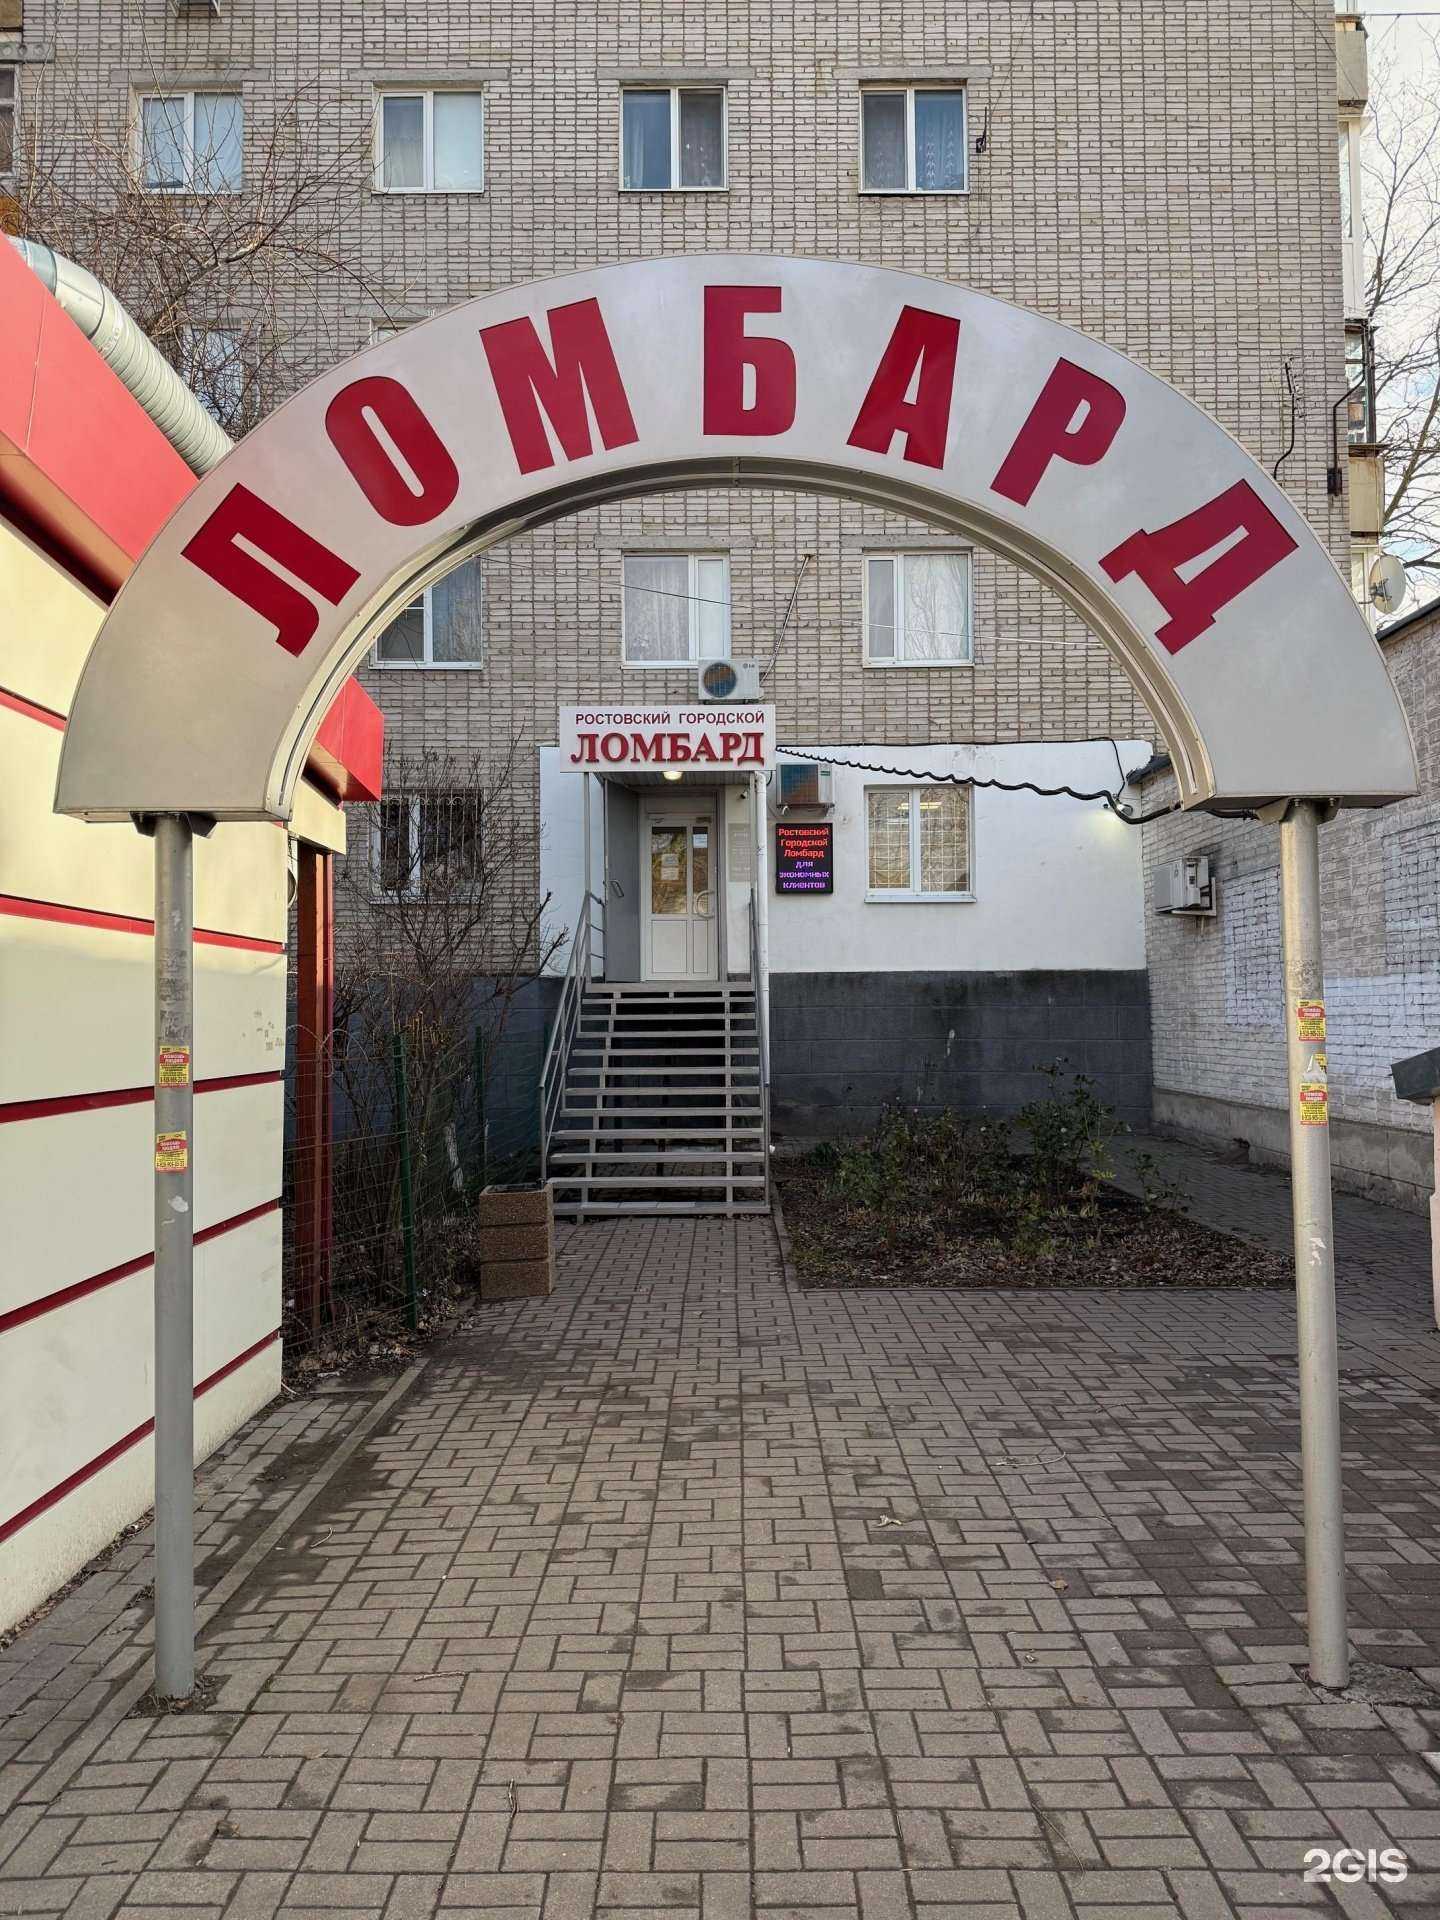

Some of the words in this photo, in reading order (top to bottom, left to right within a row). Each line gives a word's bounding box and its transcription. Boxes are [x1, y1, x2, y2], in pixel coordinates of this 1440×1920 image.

[181, 286, 1299, 657] ЛОМБАРД
[575, 711, 671, 725] РОСТОВСКИЙ
[679, 710, 765, 726] ГОРОДСКОЙ
[570, 732, 765, 766] ЛОМБАРД
[778, 827, 829, 836] Ростовский
[780, 838, 828, 848] Городской
[784, 849, 825, 859] Ломбард
[795, 861, 814, 869] для
